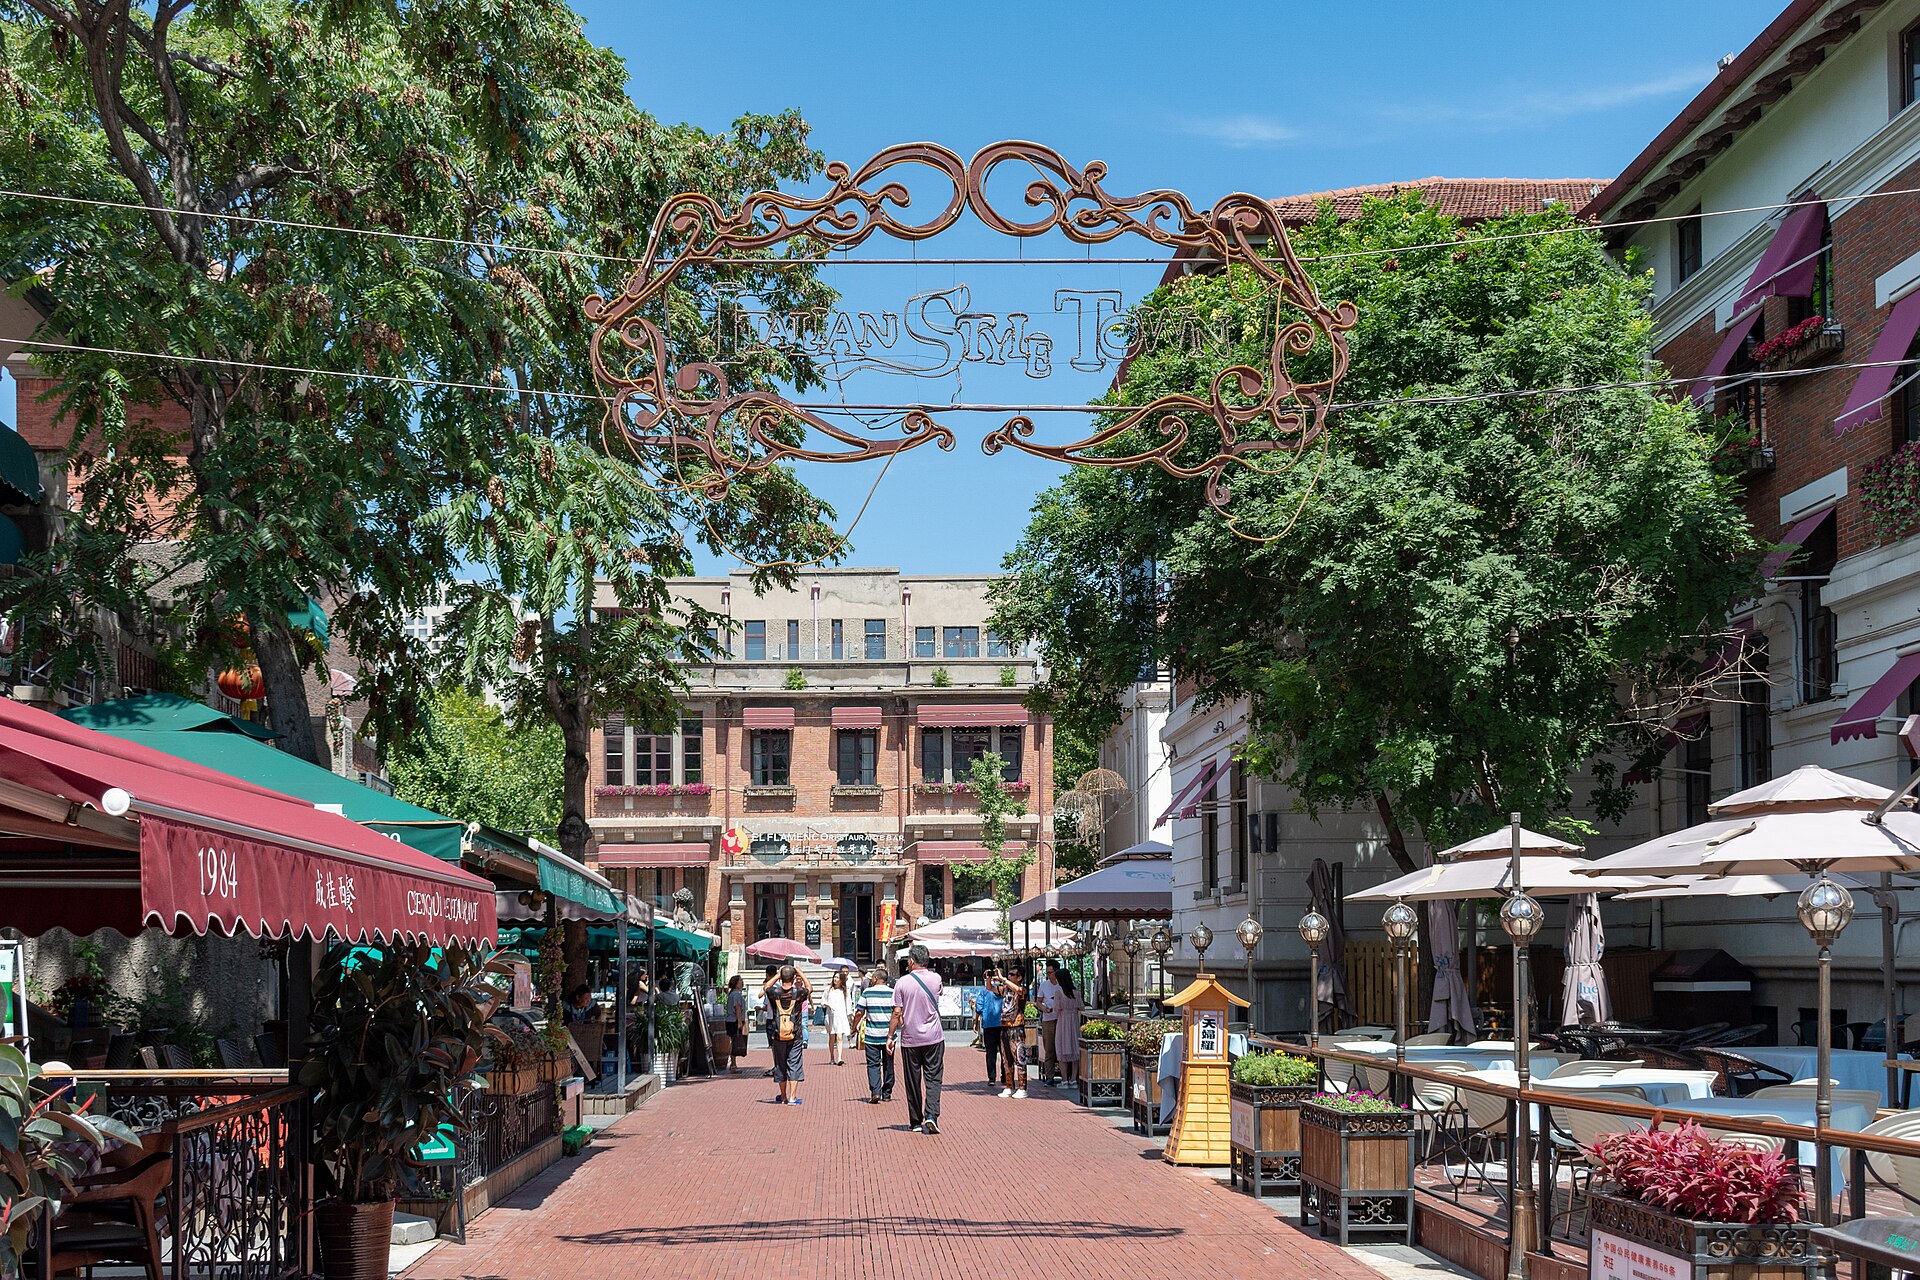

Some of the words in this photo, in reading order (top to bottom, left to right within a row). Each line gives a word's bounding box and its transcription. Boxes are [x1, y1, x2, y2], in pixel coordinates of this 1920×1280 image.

[1054, 287, 1233, 372] TOWN
[751, 832, 765, 842] EL
[767, 832, 828, 842] FLAMENCO
[886, 834, 905, 842] BAR
[197, 847, 239, 899] 1984
[1578, 982, 1598, 994] lue
